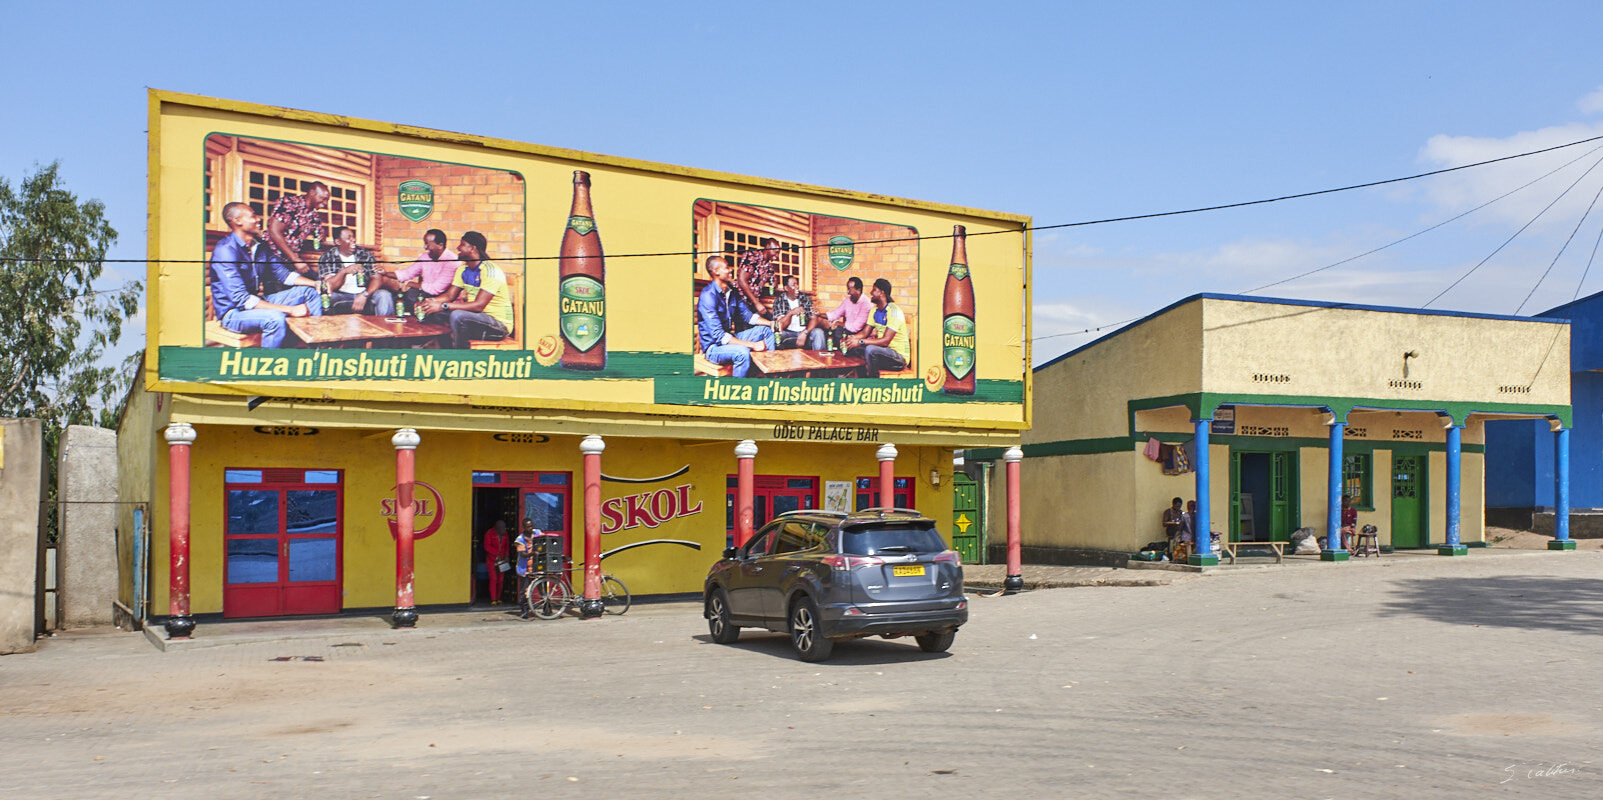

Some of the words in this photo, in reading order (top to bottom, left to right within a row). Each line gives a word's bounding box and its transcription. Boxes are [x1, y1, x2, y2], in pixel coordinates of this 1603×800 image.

[562, 297, 604, 316] GATANU
[944, 333, 974, 349] GATANU
[219, 349, 291, 377] Huza
[413, 353, 532, 380] Nyanshuti
[703, 379, 753, 402] Huza
[839, 382, 924, 405] Nyanshuti
[773, 424, 805, 441] ODEO
[808, 425, 853, 442] PALACE
[856, 427, 879, 443] BAR
[381, 498, 433, 516] SL
[601, 483, 703, 534] SKOL
